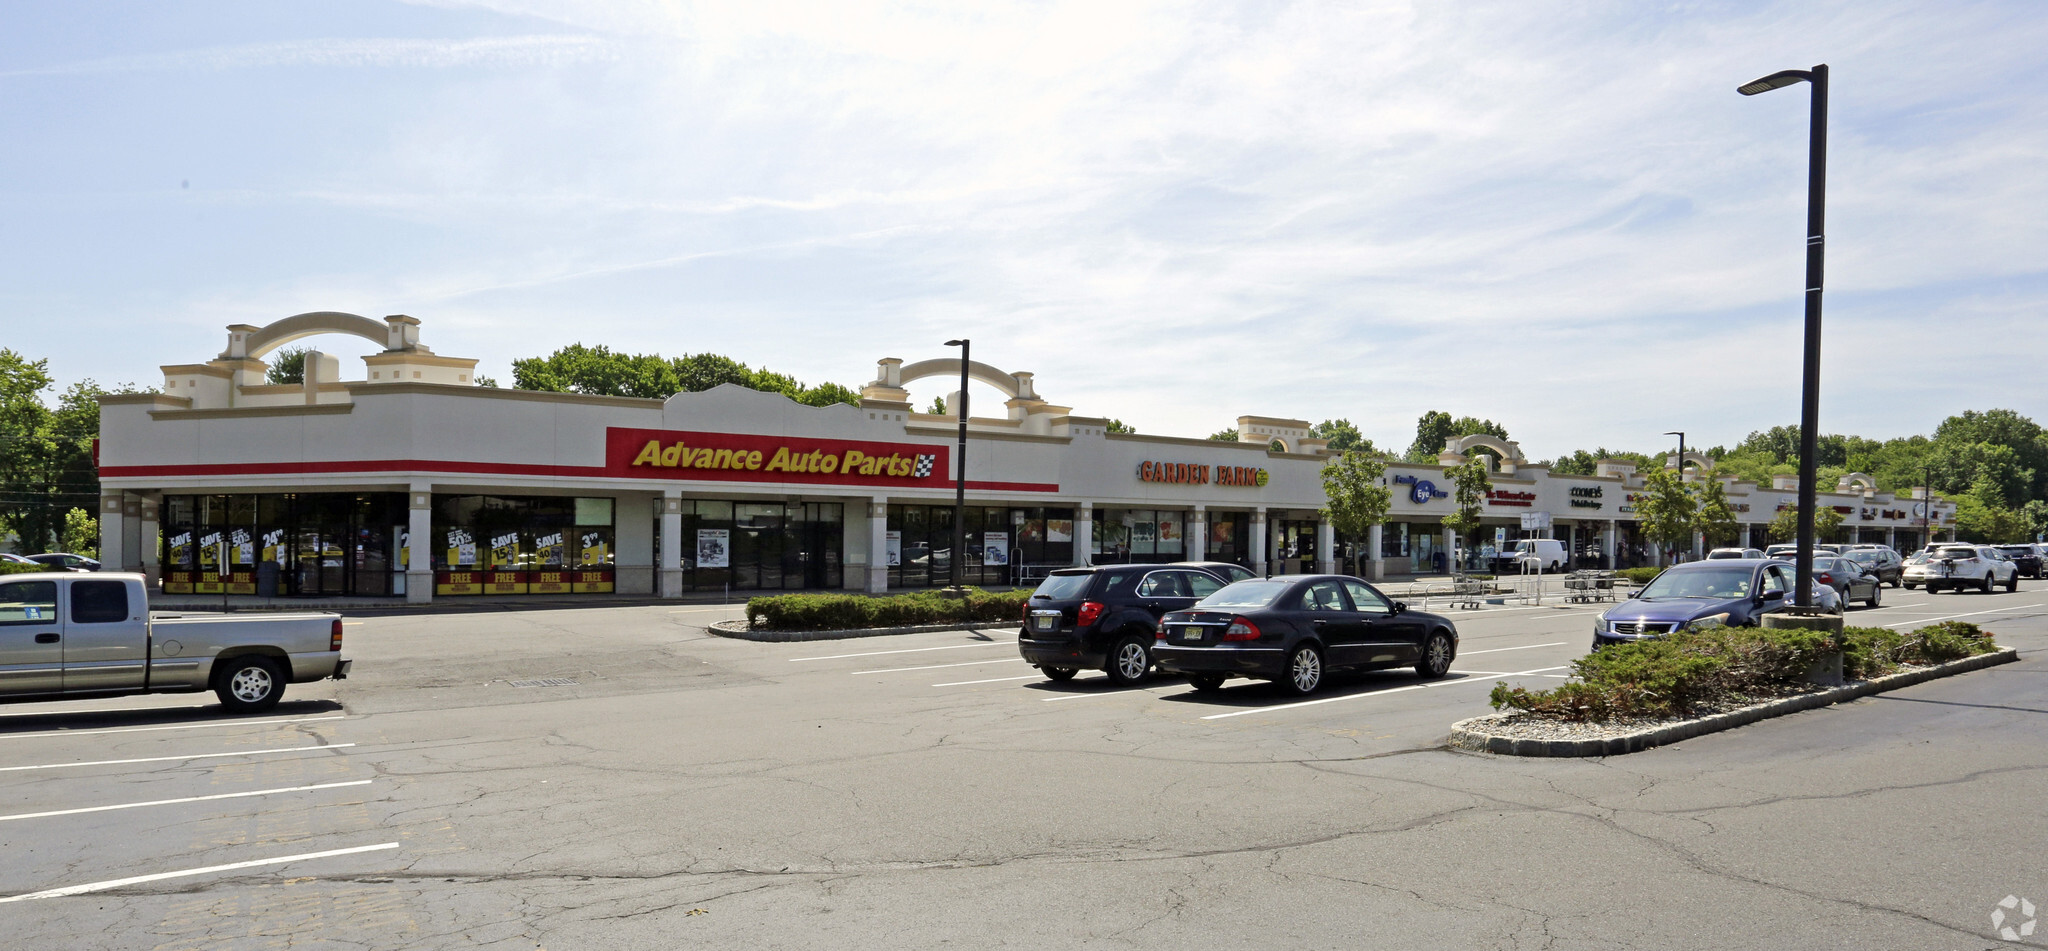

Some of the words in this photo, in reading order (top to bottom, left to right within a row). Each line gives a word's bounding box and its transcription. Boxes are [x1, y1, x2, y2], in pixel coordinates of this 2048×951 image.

[632, 440, 763, 470] Advance
[764, 446, 839, 474] Auto
[840, 450, 912, 477] Parts
[1140, 461, 1210, 485] GARDEN
[1216, 465, 1257, 486] FARM
[1417, 489, 1430, 500] Eye
[170, 532, 192, 548] SAVE
[200, 532, 222, 548] SAVE
[491, 532, 519, 549] SAVE
[536, 532, 563, 549] SAVE
[173, 572, 190, 582] FREE
[203, 572, 219, 582] FREE
[234, 572, 250, 583] FREE
[450, 572, 472, 583] FREE
[495, 572, 515, 583] FREE
[541, 572, 561, 583] FREE
[582, 572, 602, 582] FREE
